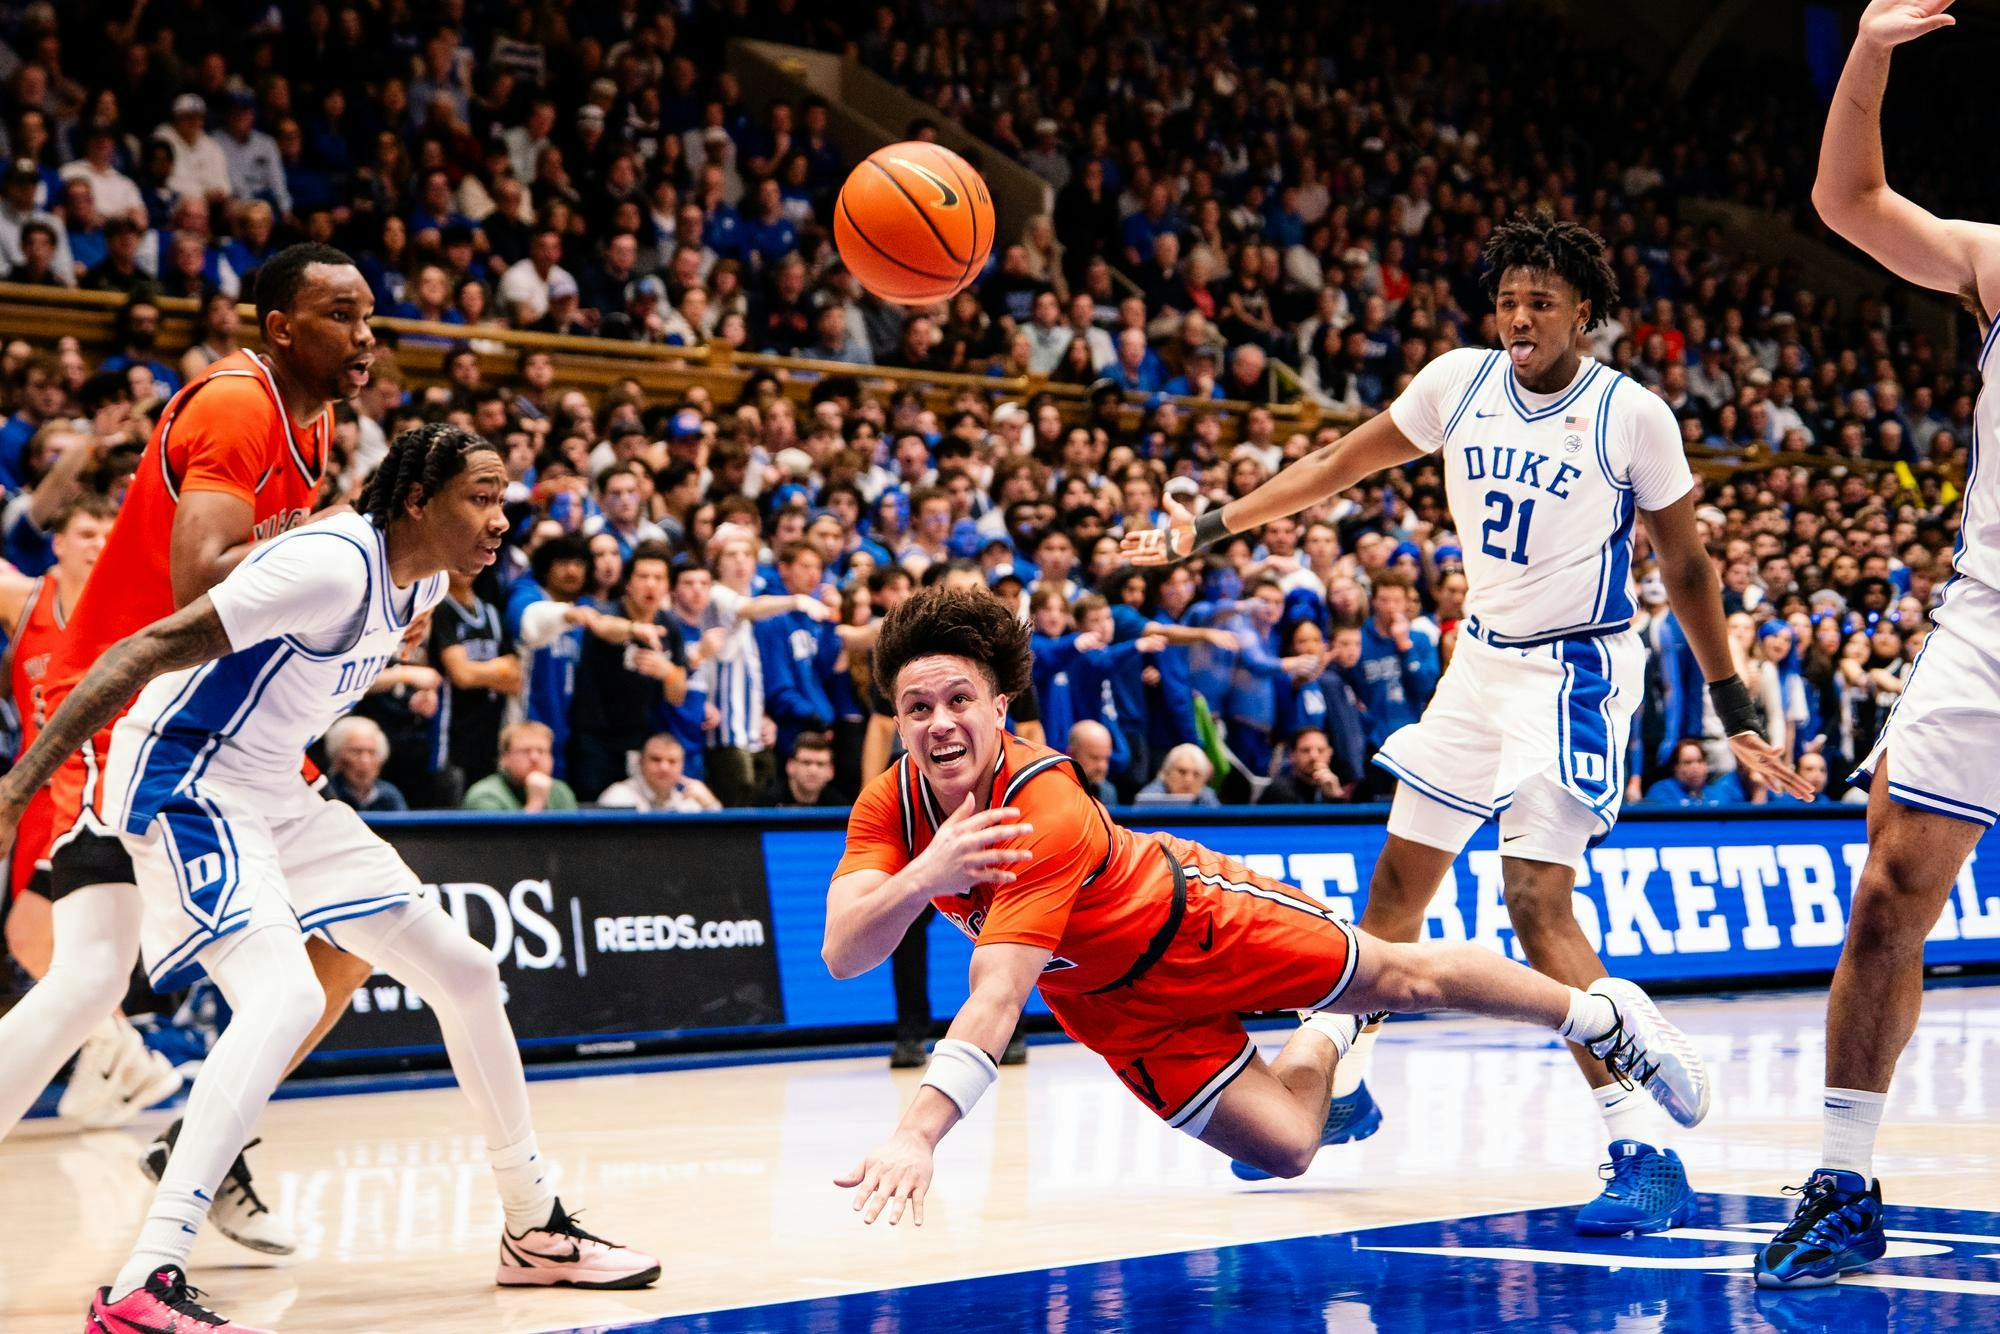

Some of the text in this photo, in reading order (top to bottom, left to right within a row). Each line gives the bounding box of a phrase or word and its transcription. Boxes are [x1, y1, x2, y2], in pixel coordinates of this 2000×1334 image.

[1464, 446, 1582, 500] DUKE
[1481, 490, 1536, 565] 21
[1573, 751, 1605, 782] D
[184, 851, 223, 893] D
[594, 914, 765, 953] REEDS.com
